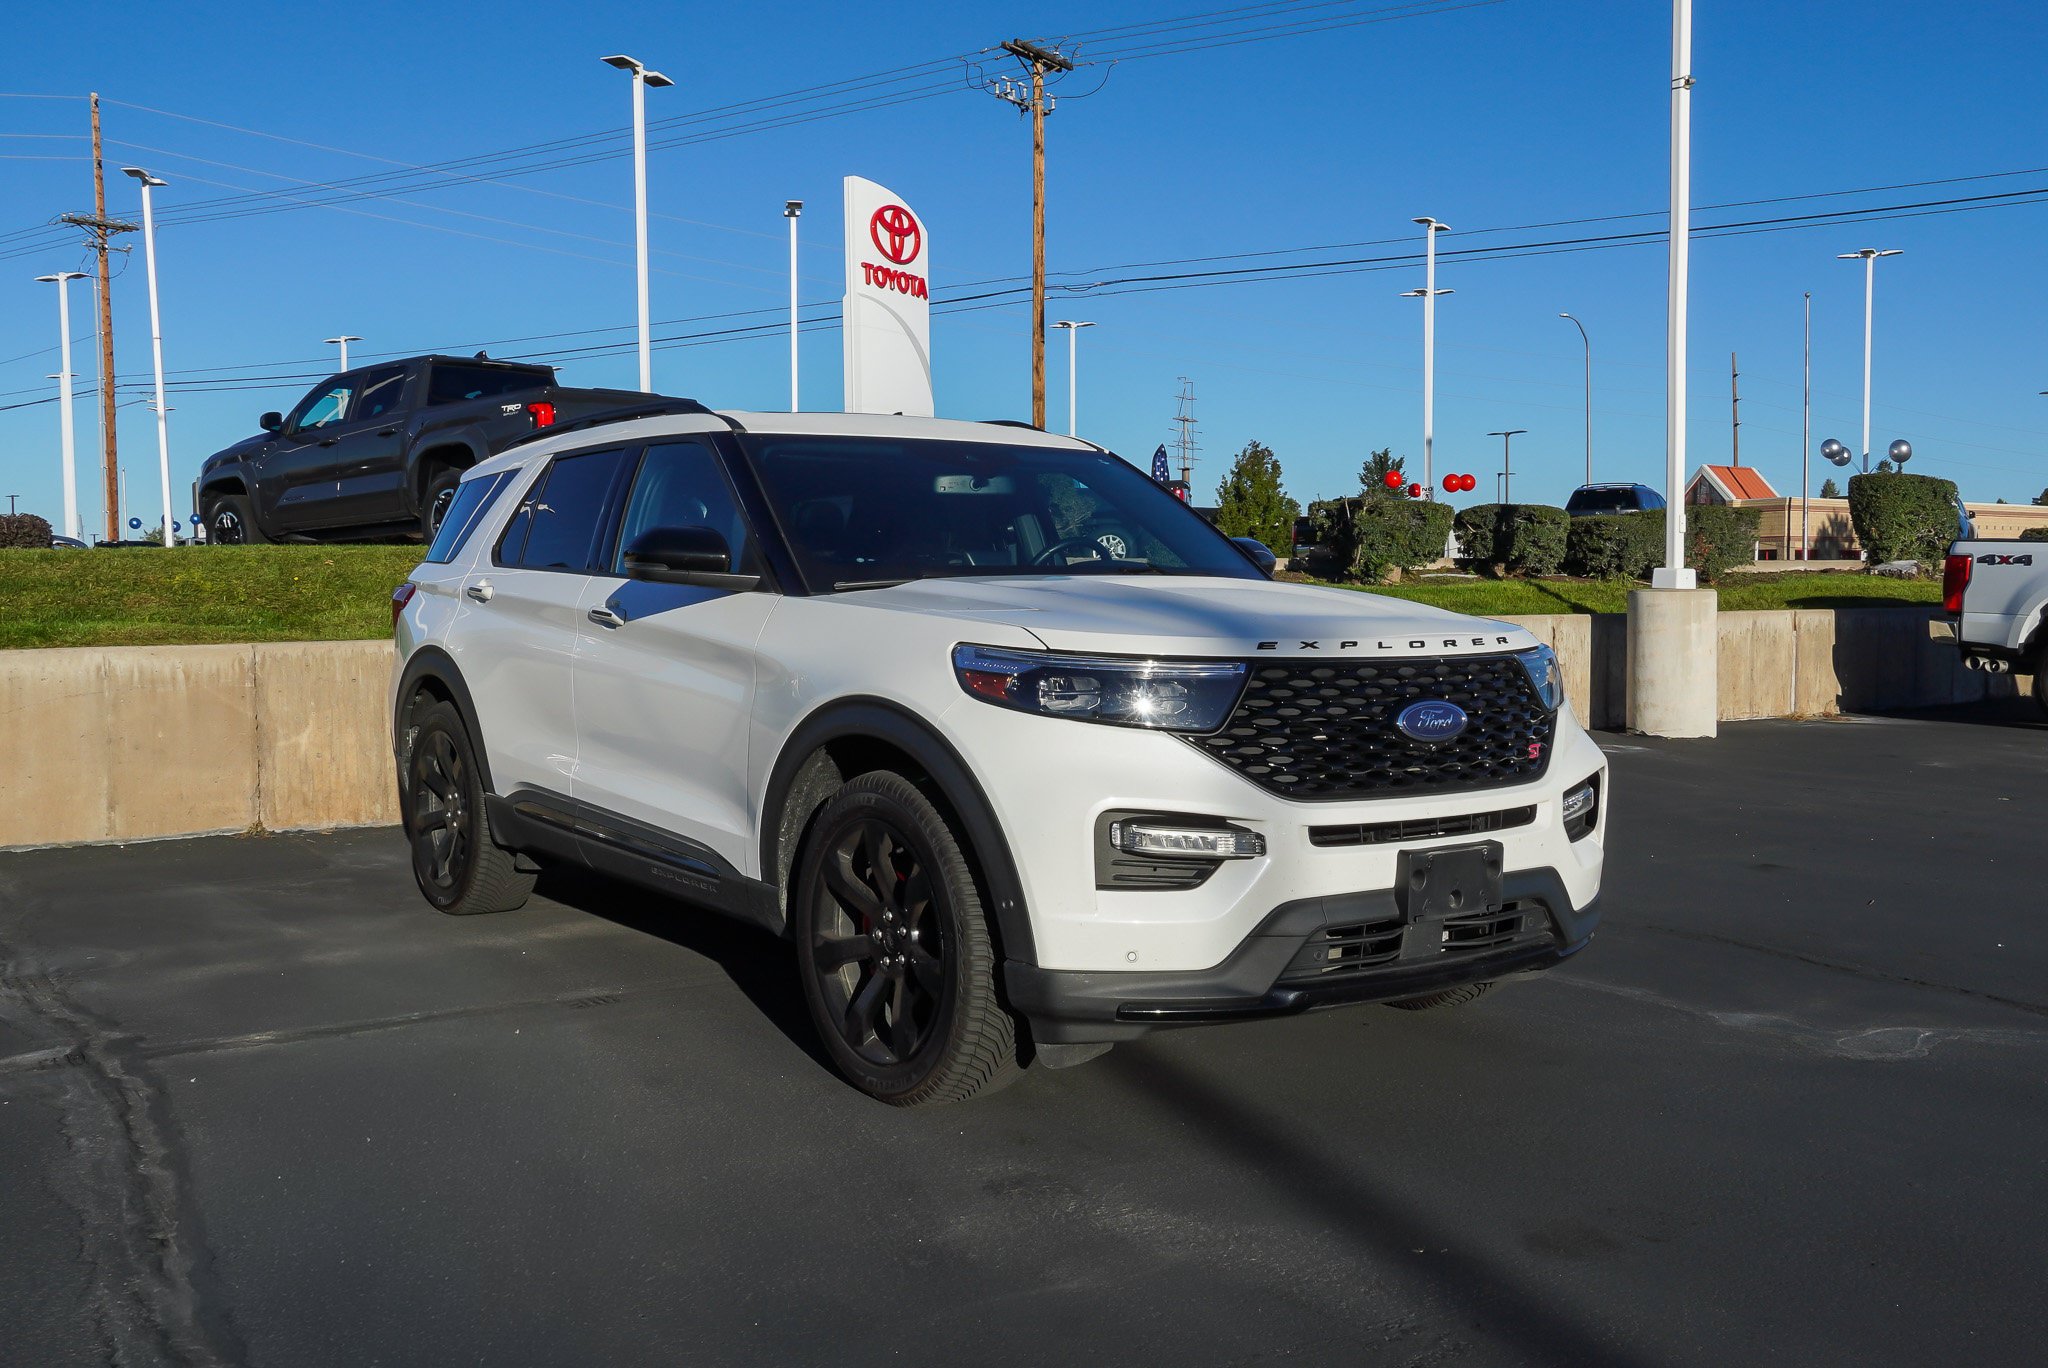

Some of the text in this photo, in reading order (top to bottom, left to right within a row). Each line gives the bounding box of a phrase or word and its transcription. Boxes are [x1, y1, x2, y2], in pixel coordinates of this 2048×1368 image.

[861, 262, 928, 300] TOYOTA
[501, 404, 521, 412] TRD
[1257, 636, 1510, 650] EXPLORER
[1417, 709, 1454, 729] Ford
